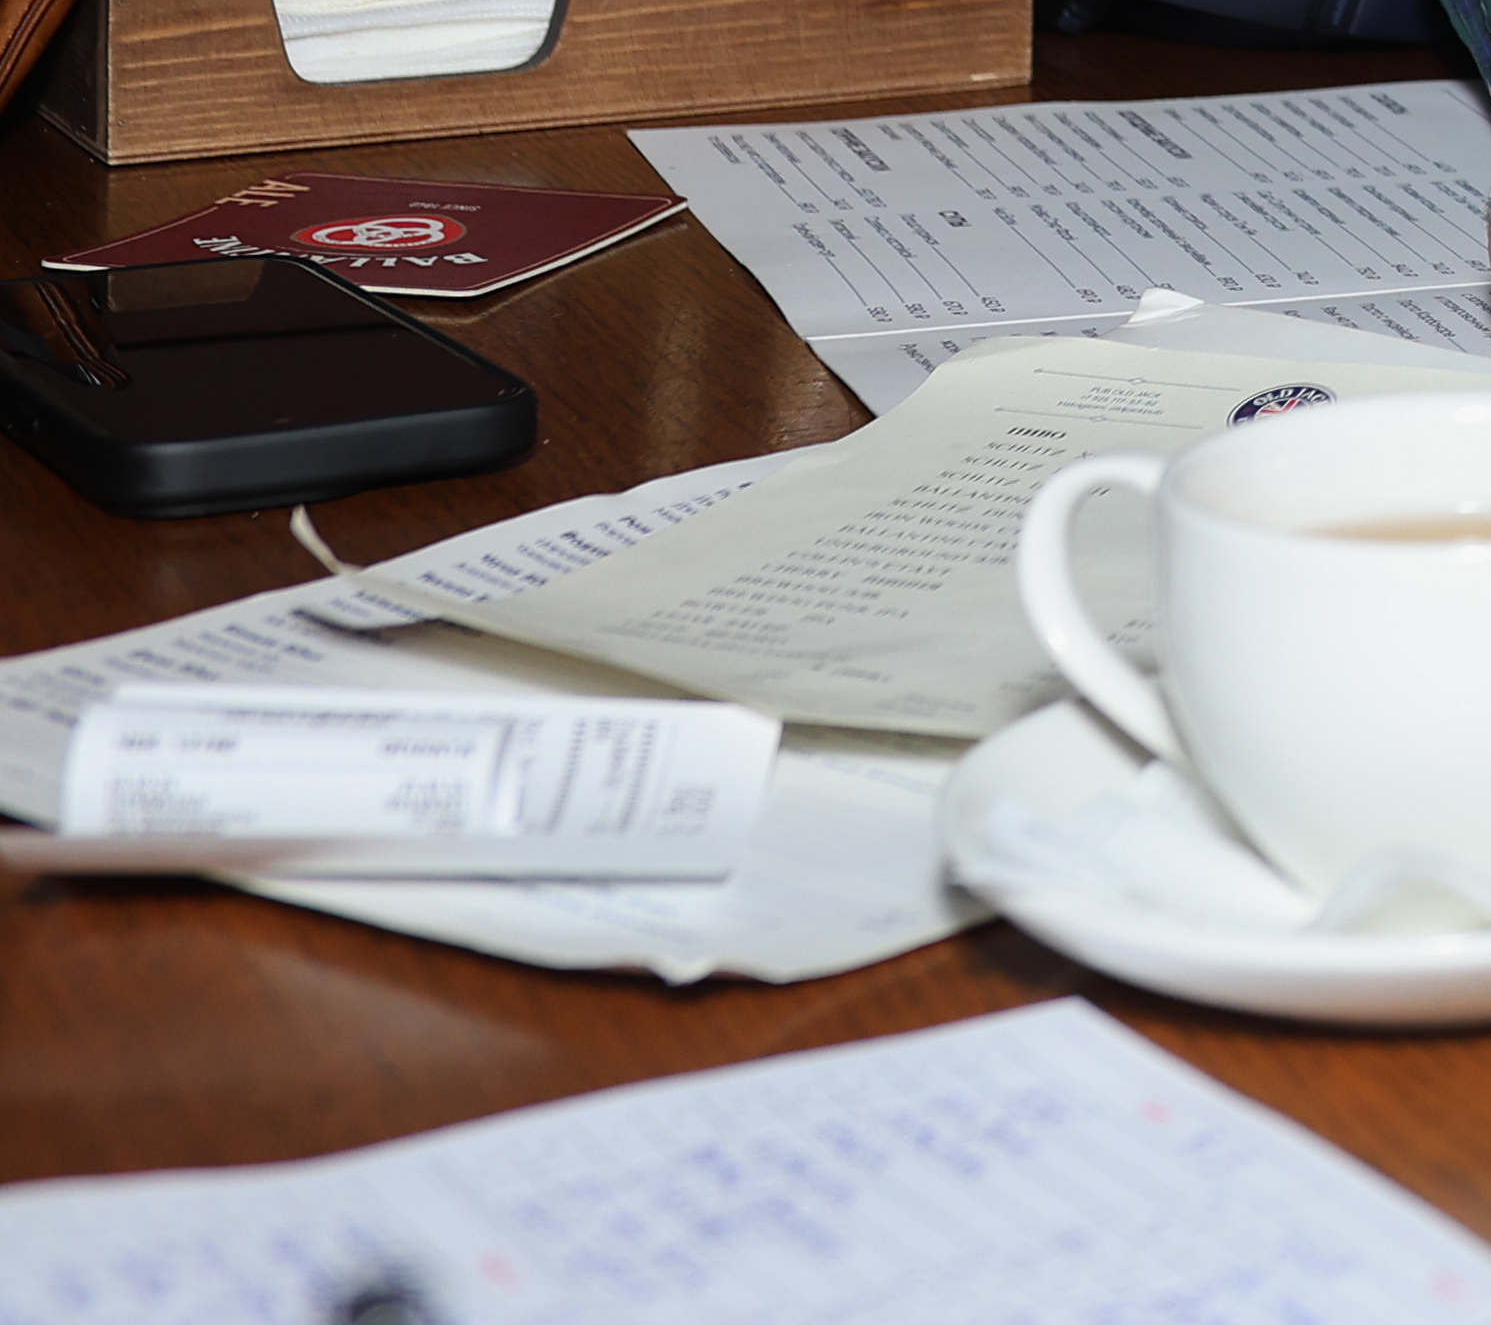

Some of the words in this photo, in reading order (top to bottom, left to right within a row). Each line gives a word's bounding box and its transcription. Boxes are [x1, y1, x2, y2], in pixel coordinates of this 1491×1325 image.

[216, 178, 311, 208] ALE
[1252, 389, 1294, 406] OLD
[1006, 426, 1067, 440] ПИВО
